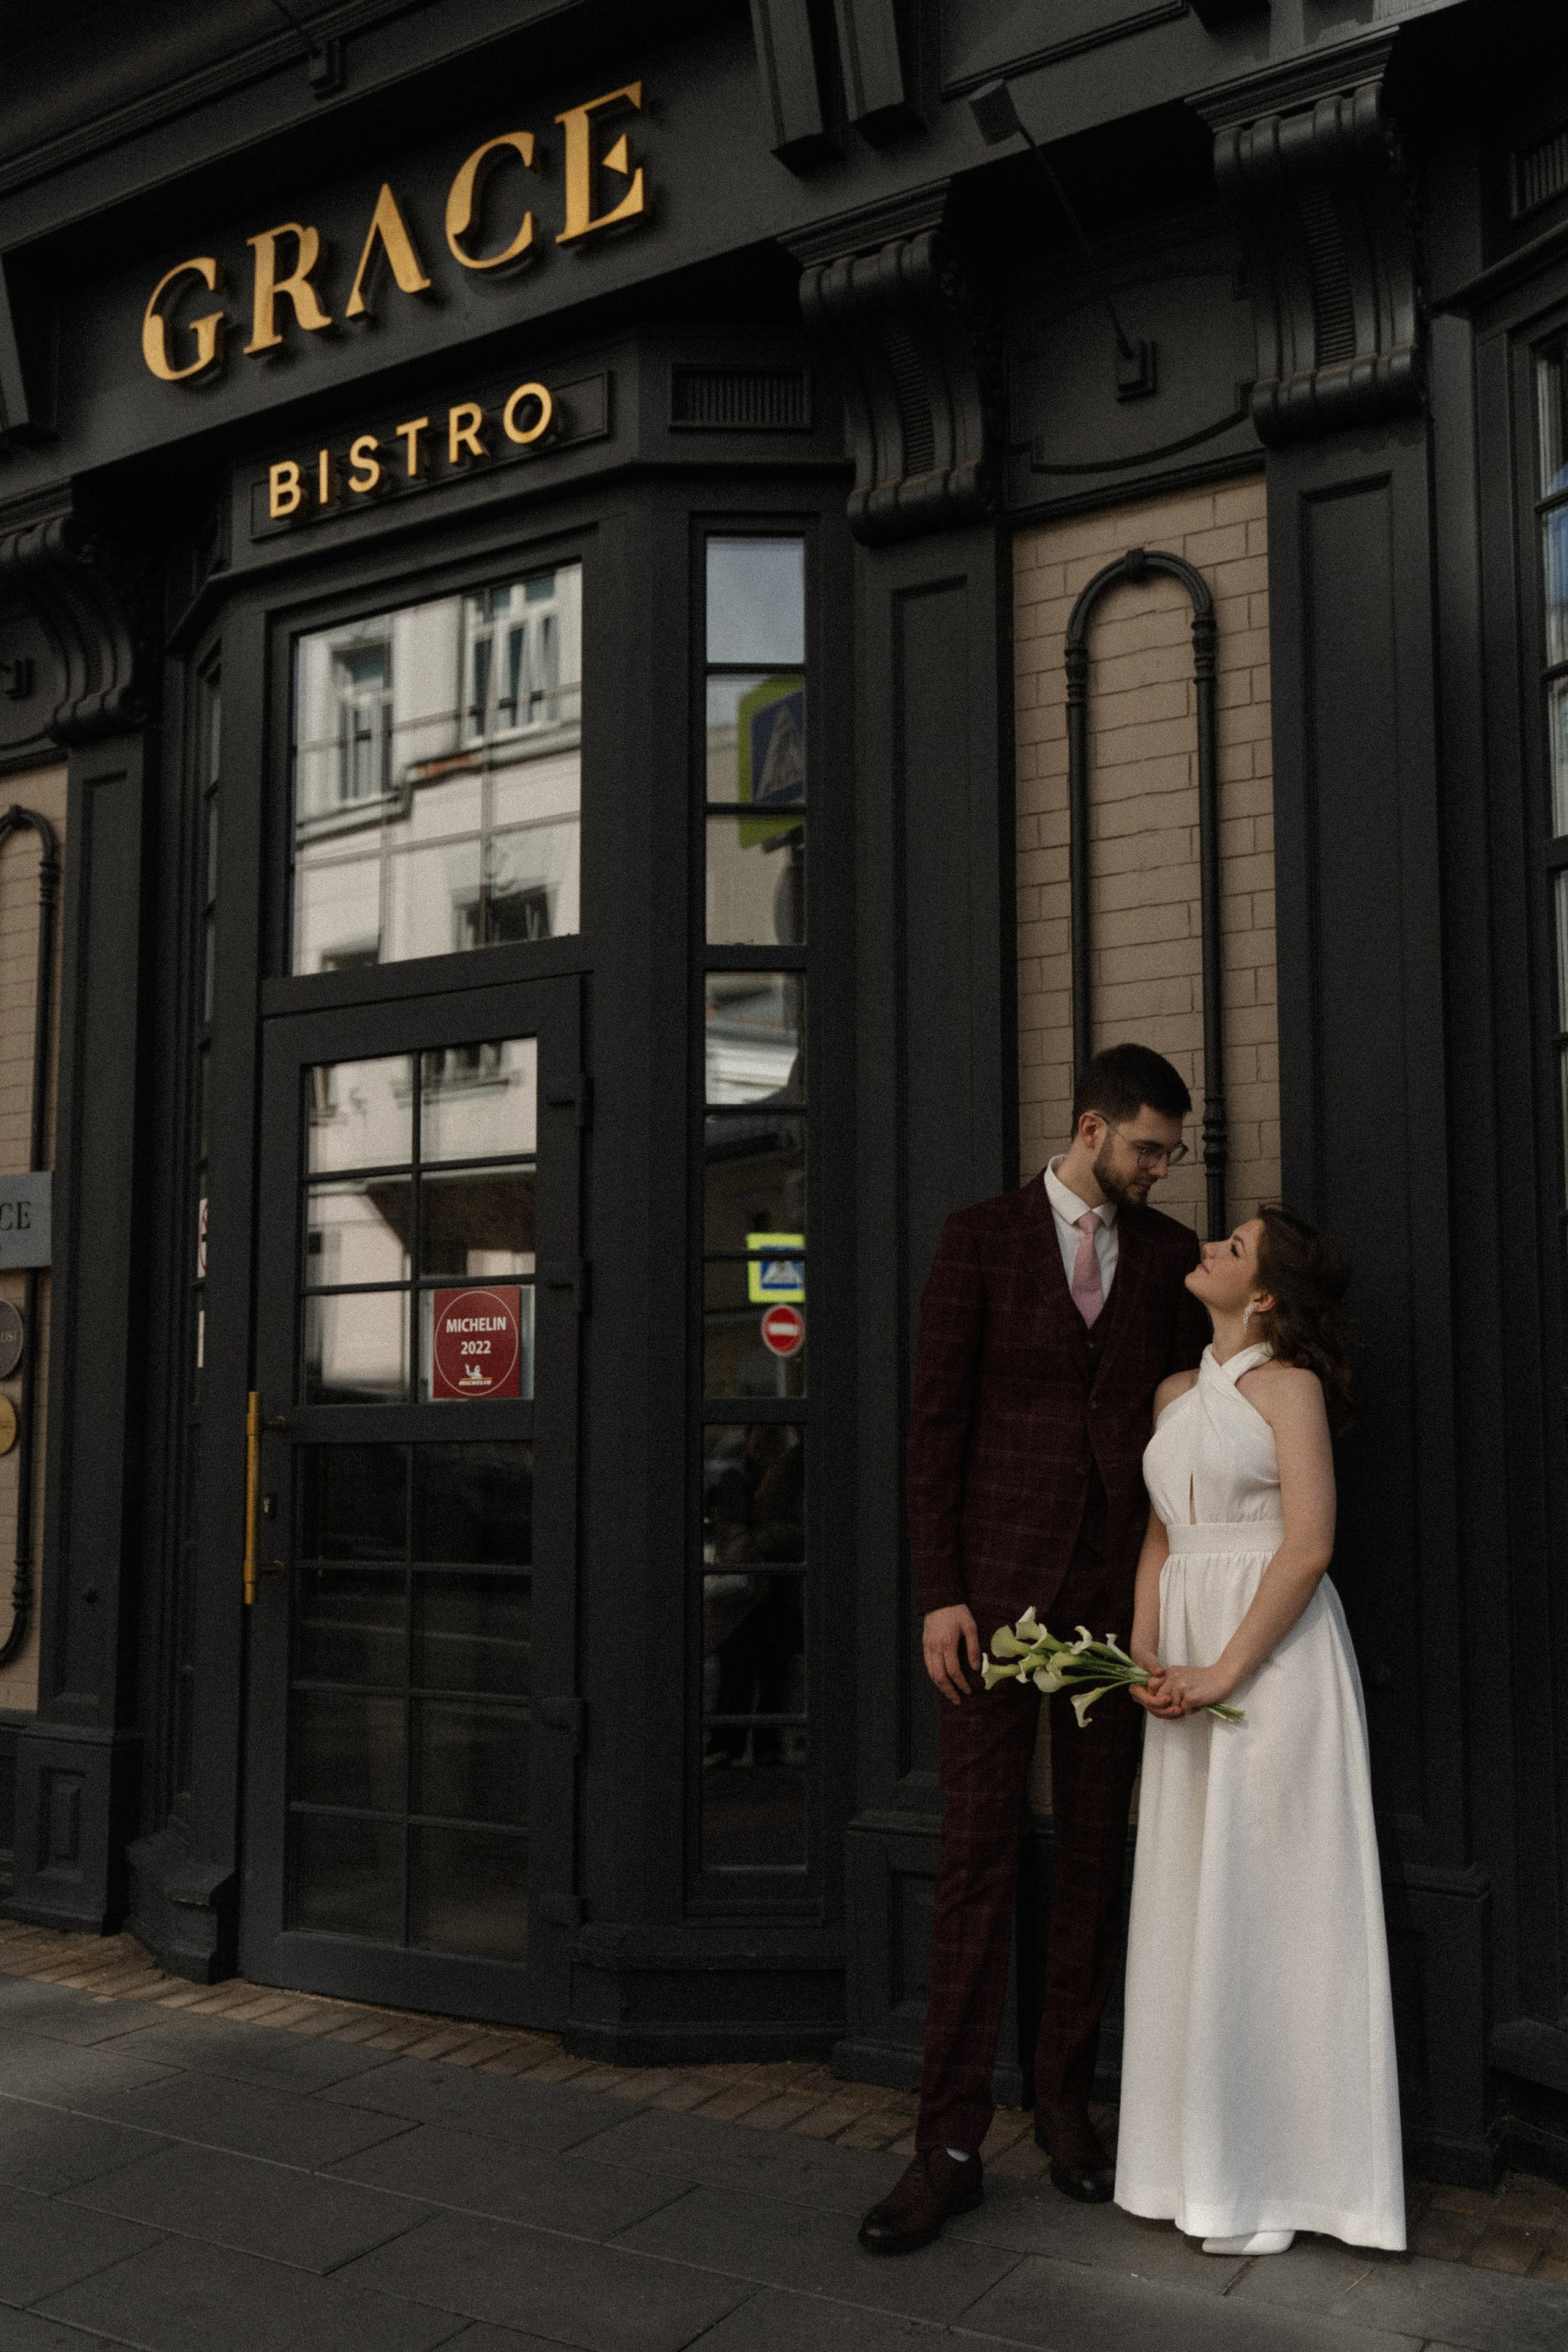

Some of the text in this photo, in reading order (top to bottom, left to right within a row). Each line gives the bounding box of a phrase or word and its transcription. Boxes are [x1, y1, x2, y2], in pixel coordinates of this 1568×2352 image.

[141, 81, 646, 381] GRACE
[270, 382, 553, 519] BISTRO
[447, 1317, 506, 1333] MICHELIN
[461, 1341, 491, 1355] 2022
